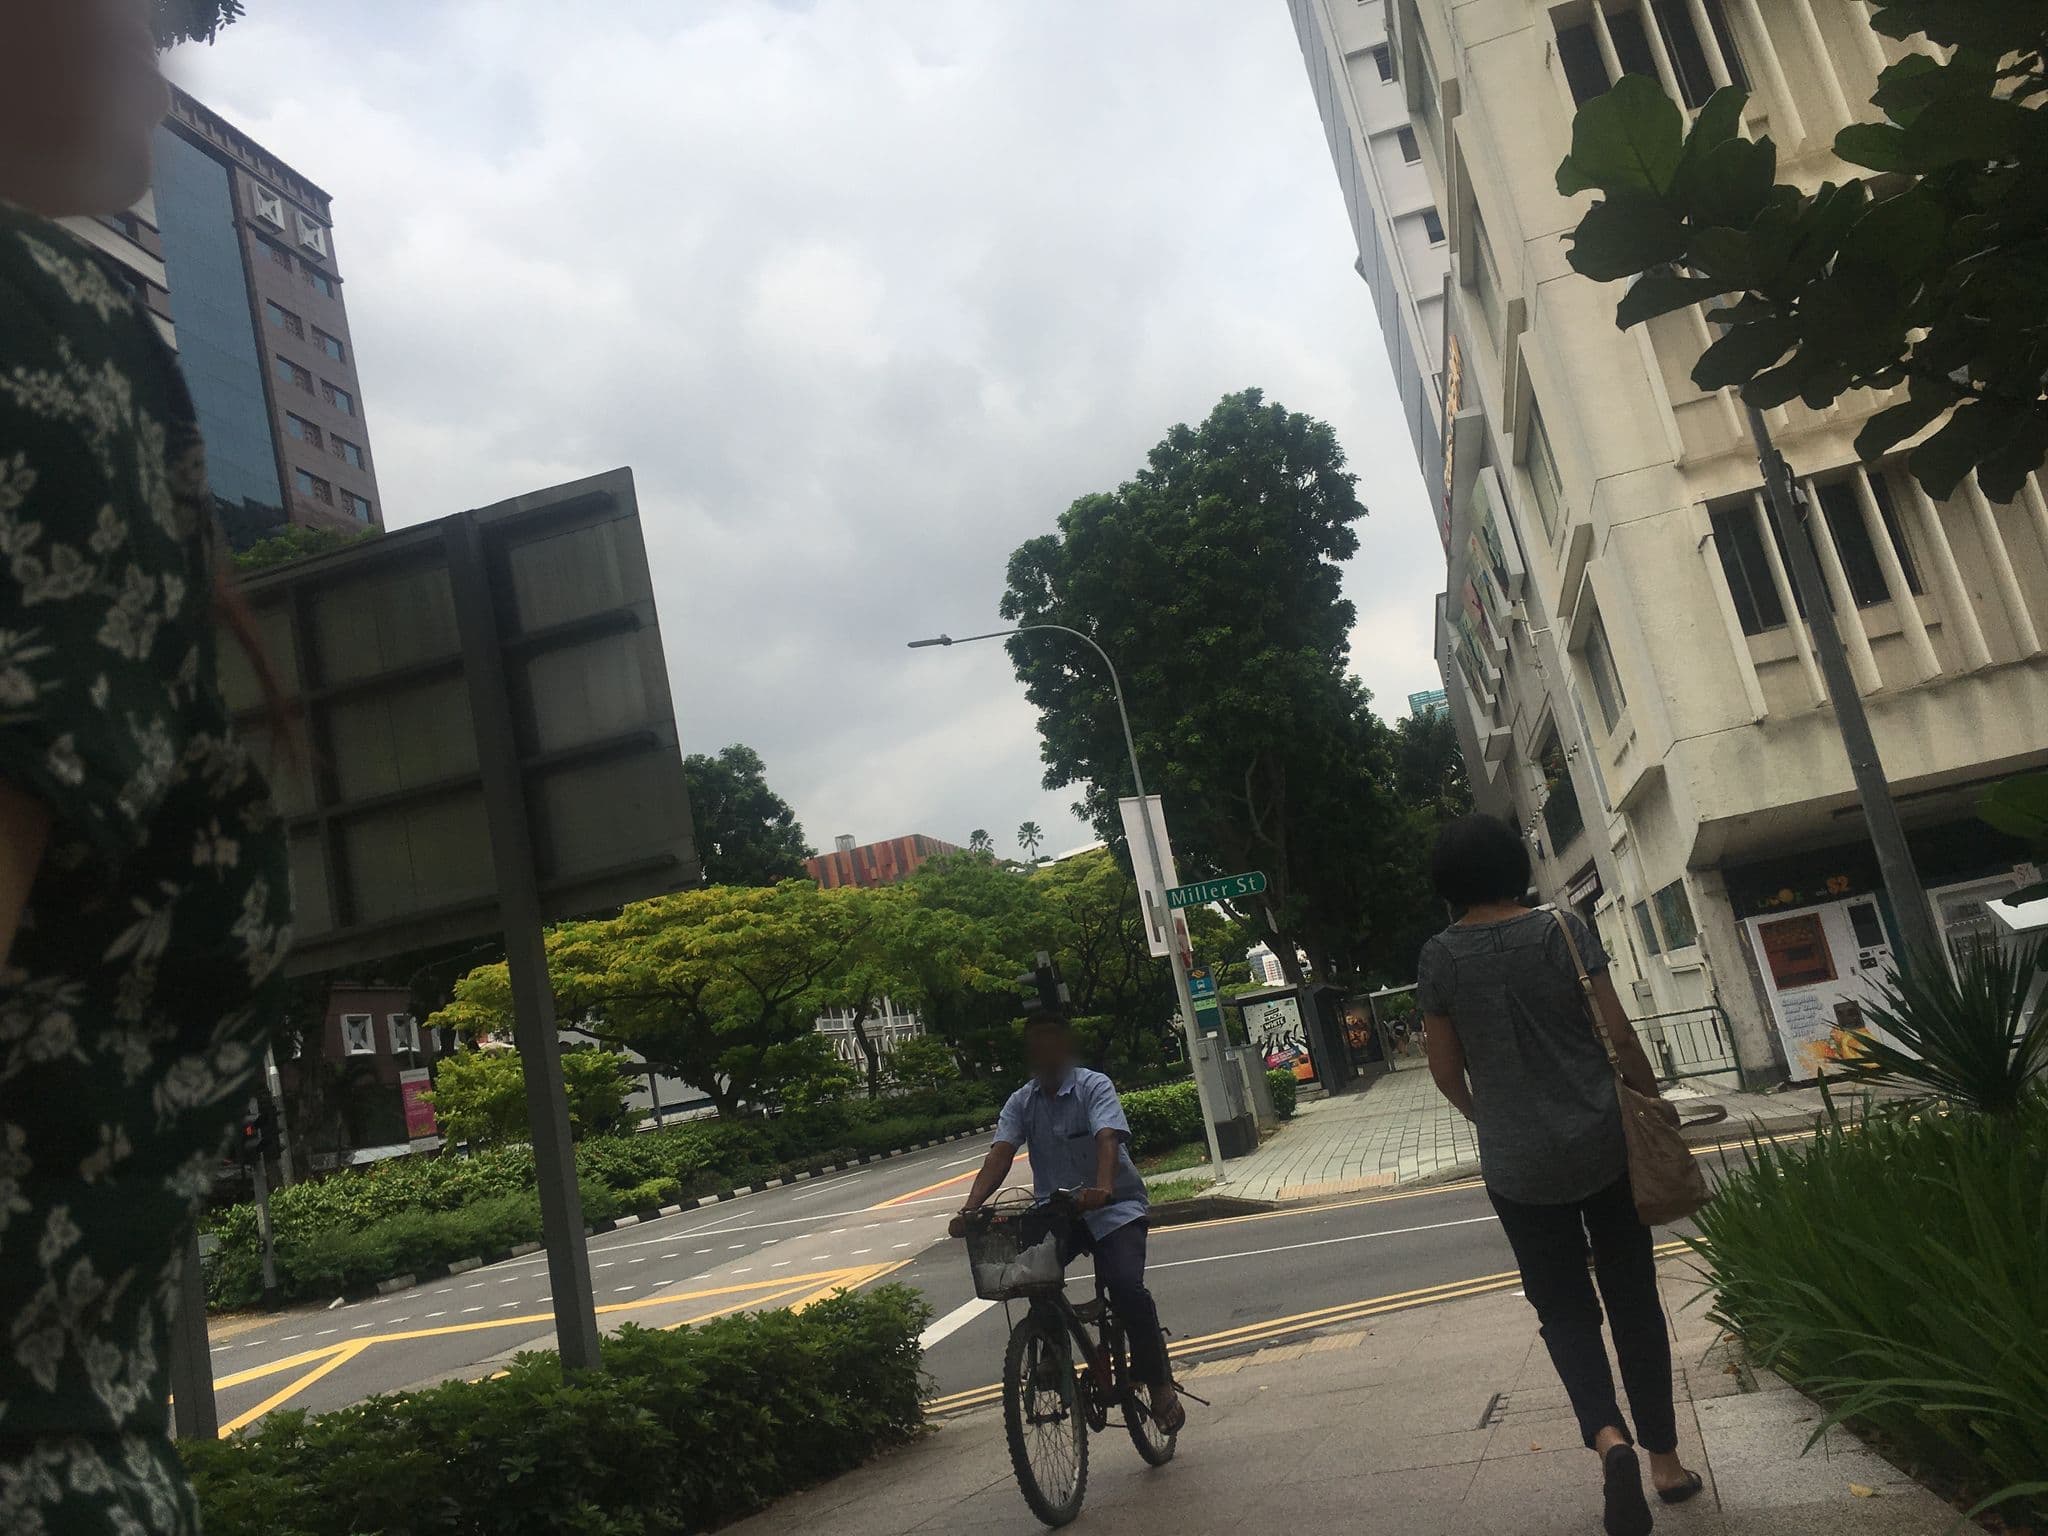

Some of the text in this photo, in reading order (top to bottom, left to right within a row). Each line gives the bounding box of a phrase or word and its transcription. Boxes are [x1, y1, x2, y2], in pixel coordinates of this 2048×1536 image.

[1171, 877, 1257, 906] Miller St
[1264, 1017, 1285, 1030] WHITE
